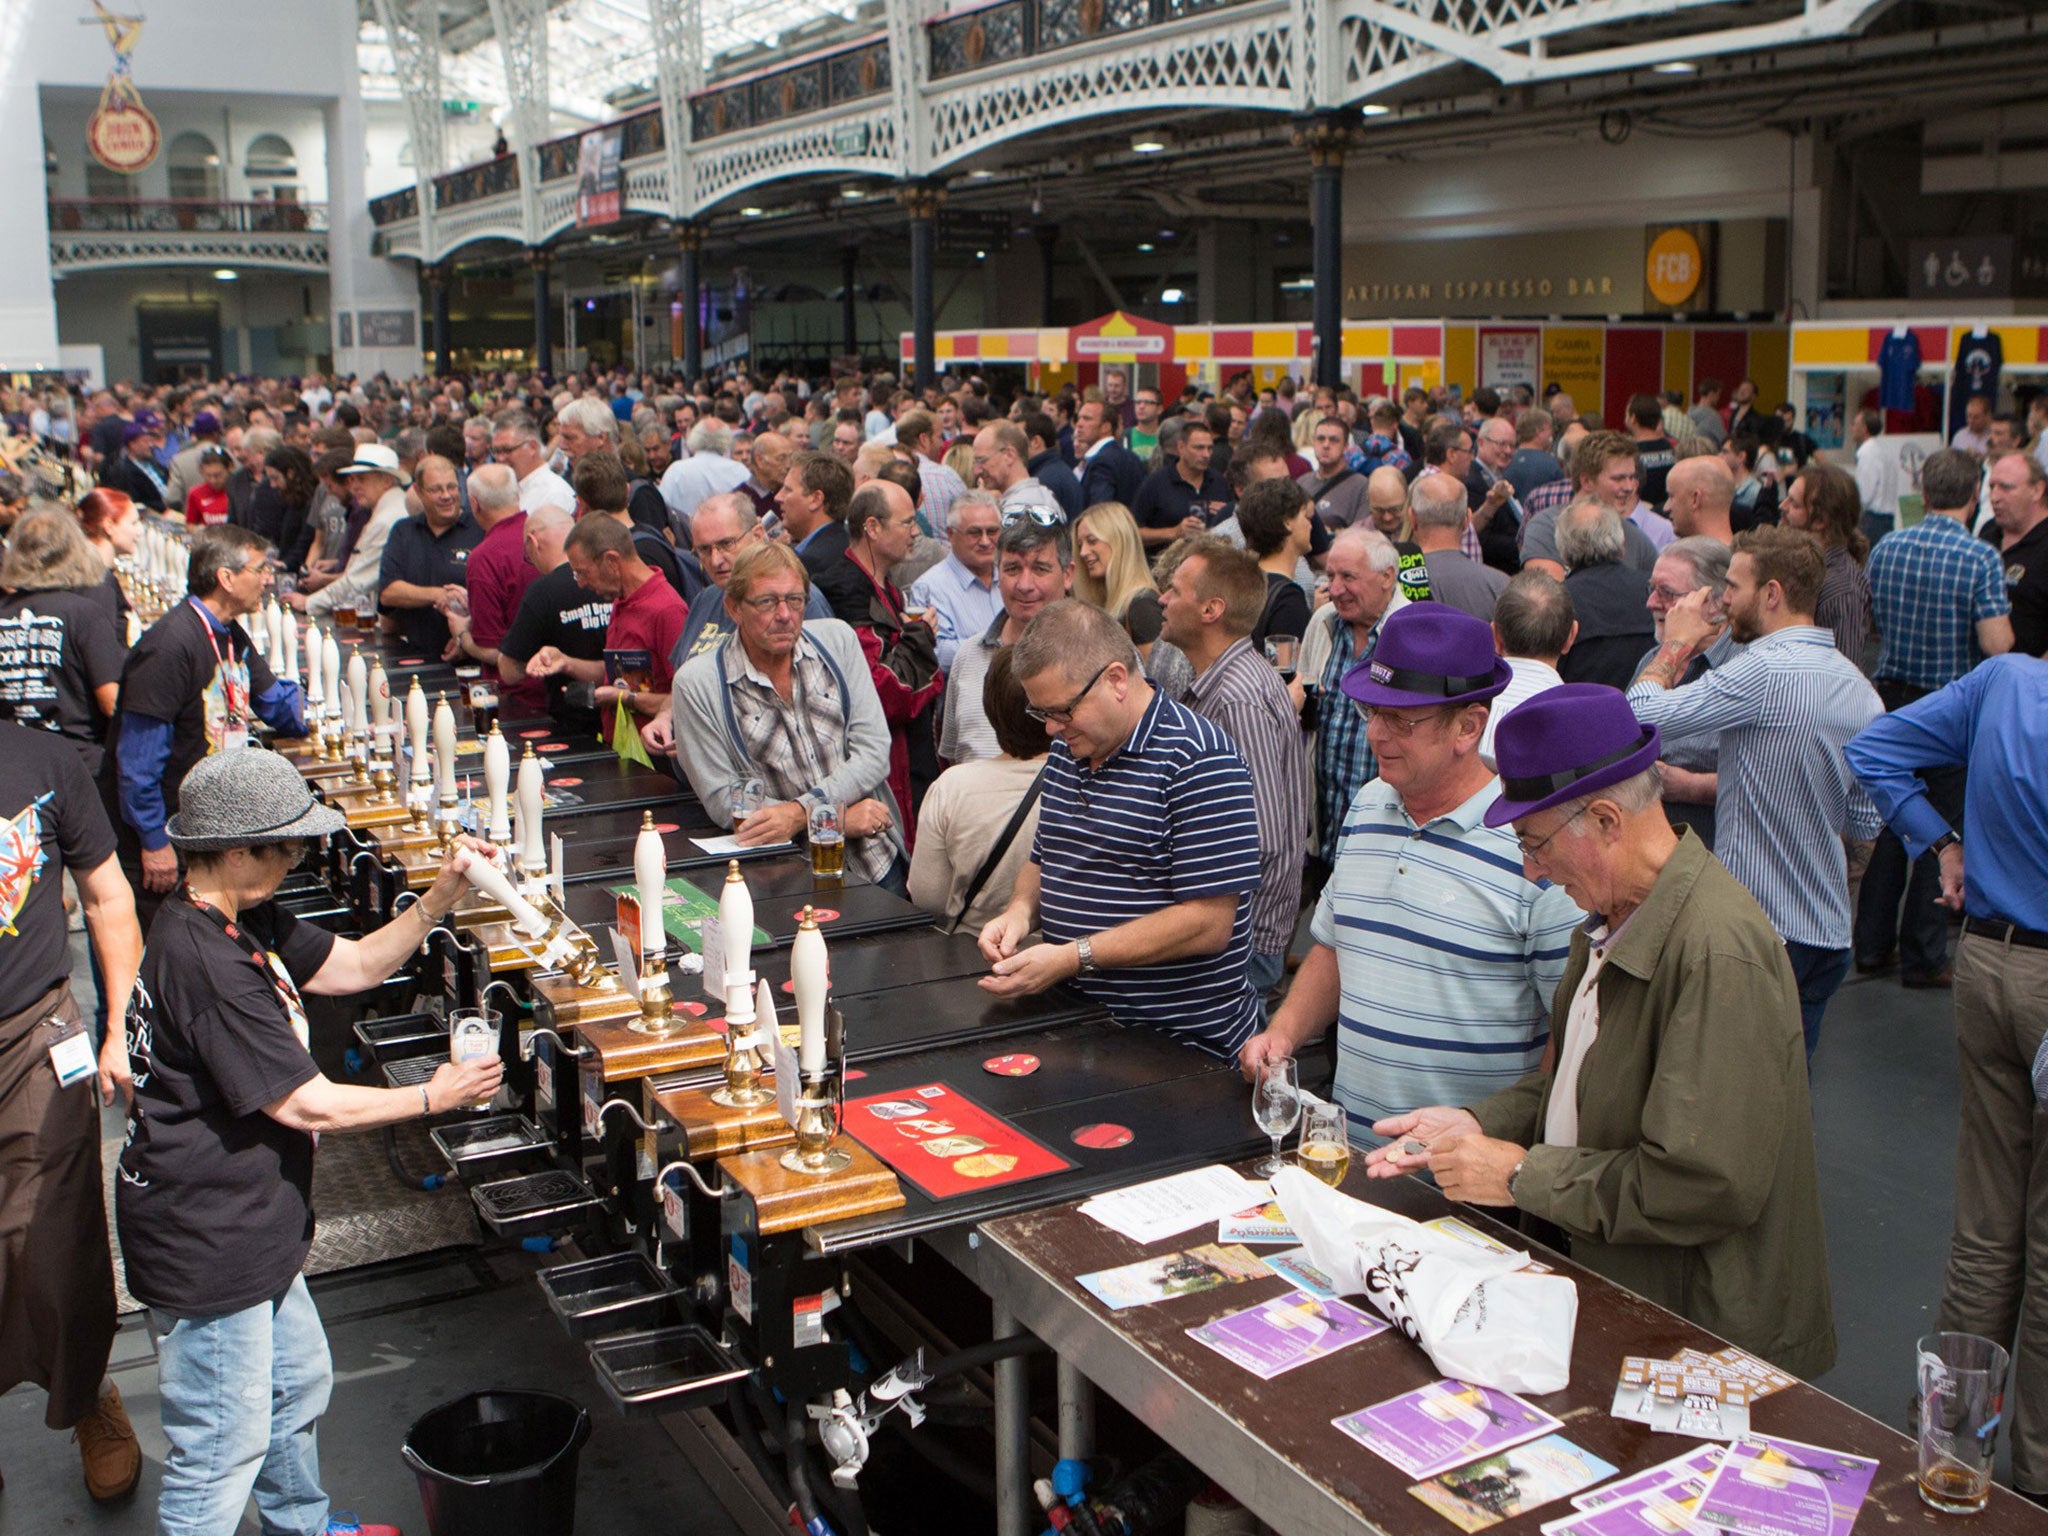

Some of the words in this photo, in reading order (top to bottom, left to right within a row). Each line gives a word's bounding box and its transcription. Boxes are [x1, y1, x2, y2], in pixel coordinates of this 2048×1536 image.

[1656, 252, 1690, 284] FCB
[1347, 283, 1431, 301] ARTISAN
[1444, 278, 1552, 300] ESPRESSO
[1568, 276, 1612, 296] BAR
[559, 603, 592, 624] Small
[581, 615, 600, 630] Big
